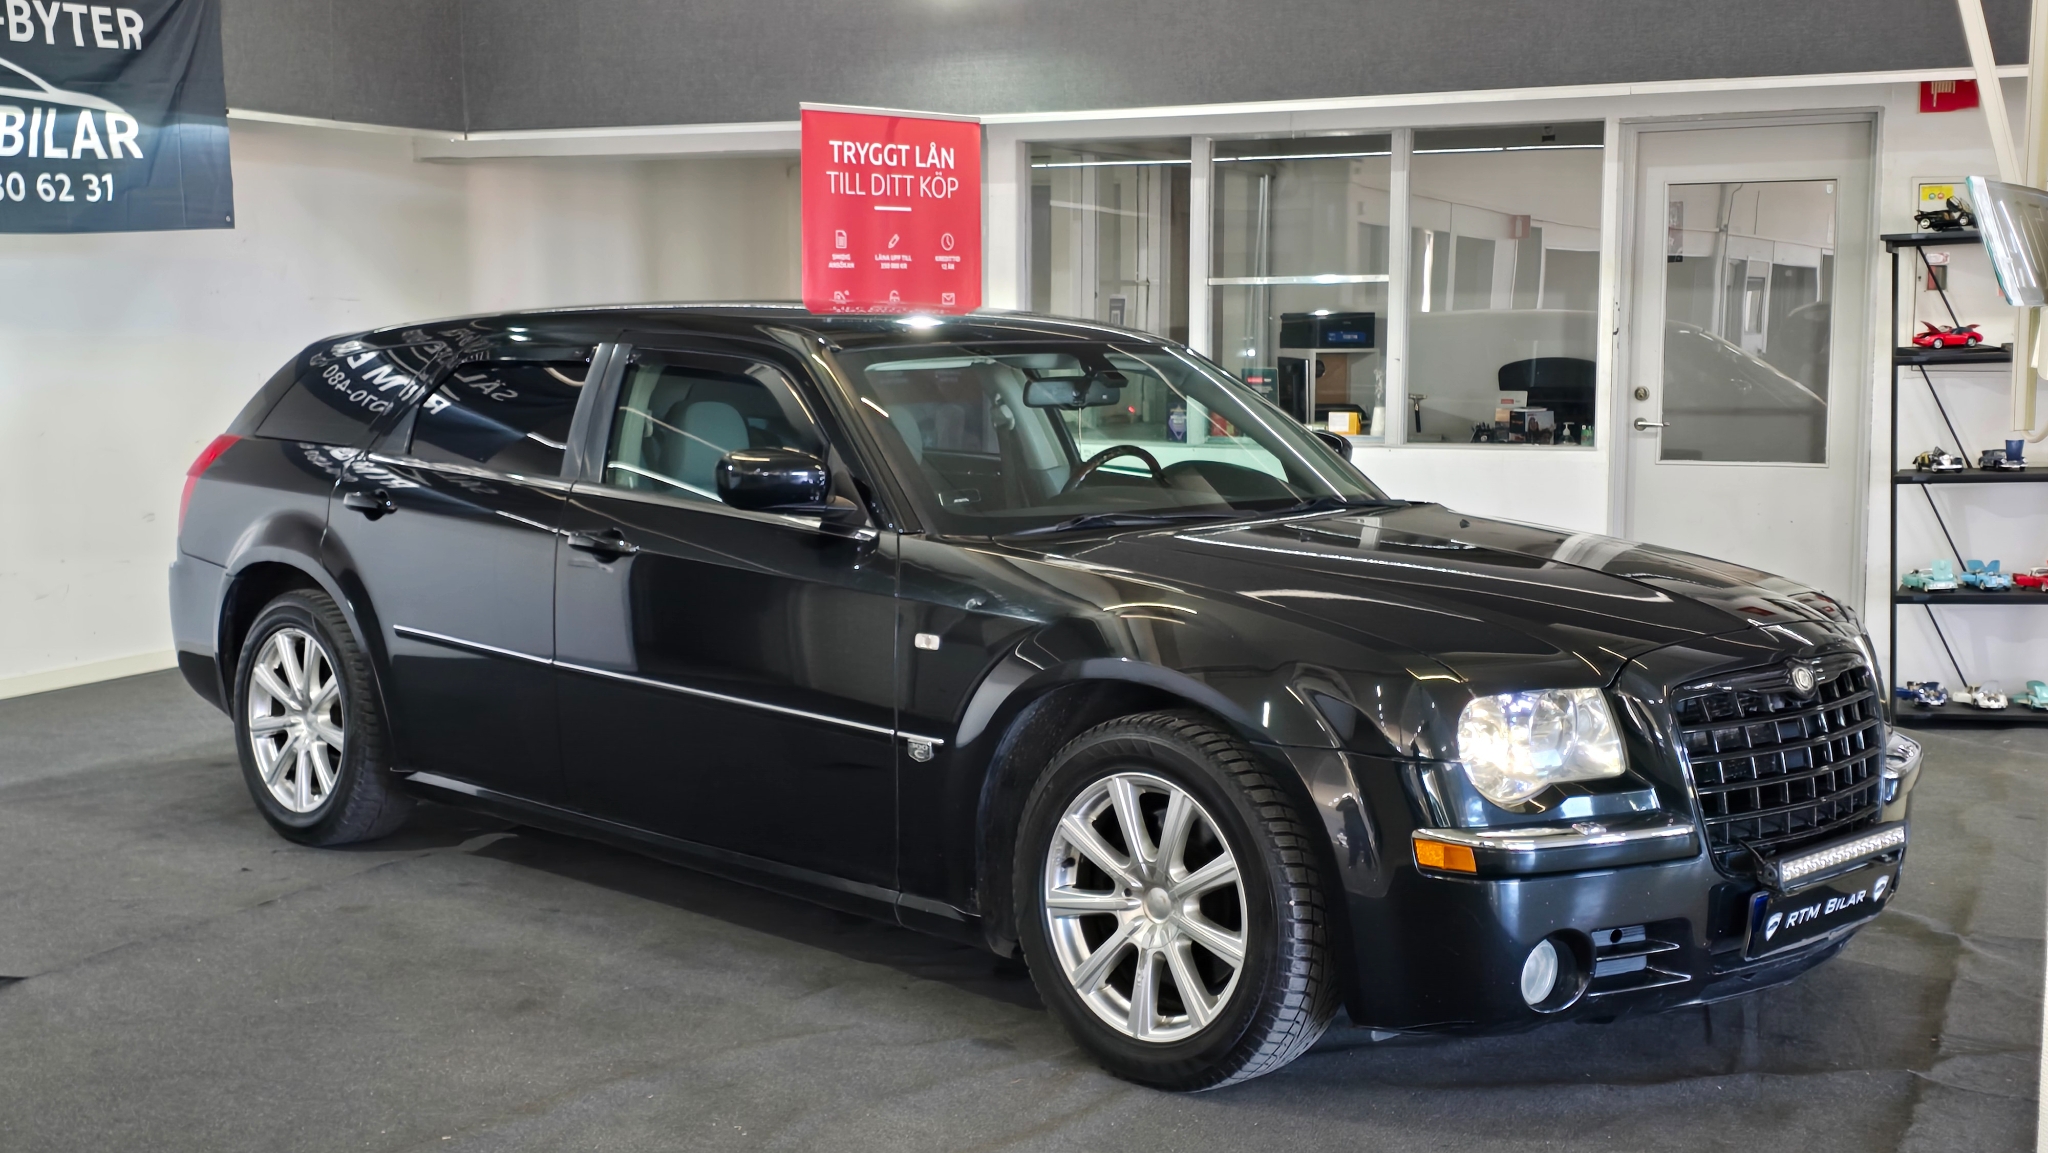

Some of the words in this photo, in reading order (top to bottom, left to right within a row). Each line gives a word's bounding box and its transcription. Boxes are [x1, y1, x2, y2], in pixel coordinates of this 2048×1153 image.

[0, 106, 144, 159] BILAR
[828, 140, 910, 167] TRYGGT
[915, 142, 955, 169] LÅN
[36, 172, 75, 202] 62
[82, 173, 114, 202] 31
[826, 171, 866, 196] TILL
[871, 173, 914, 197] DITT
[920, 171, 959, 199] KÖP
[1785, 903, 1822, 929] RTM
